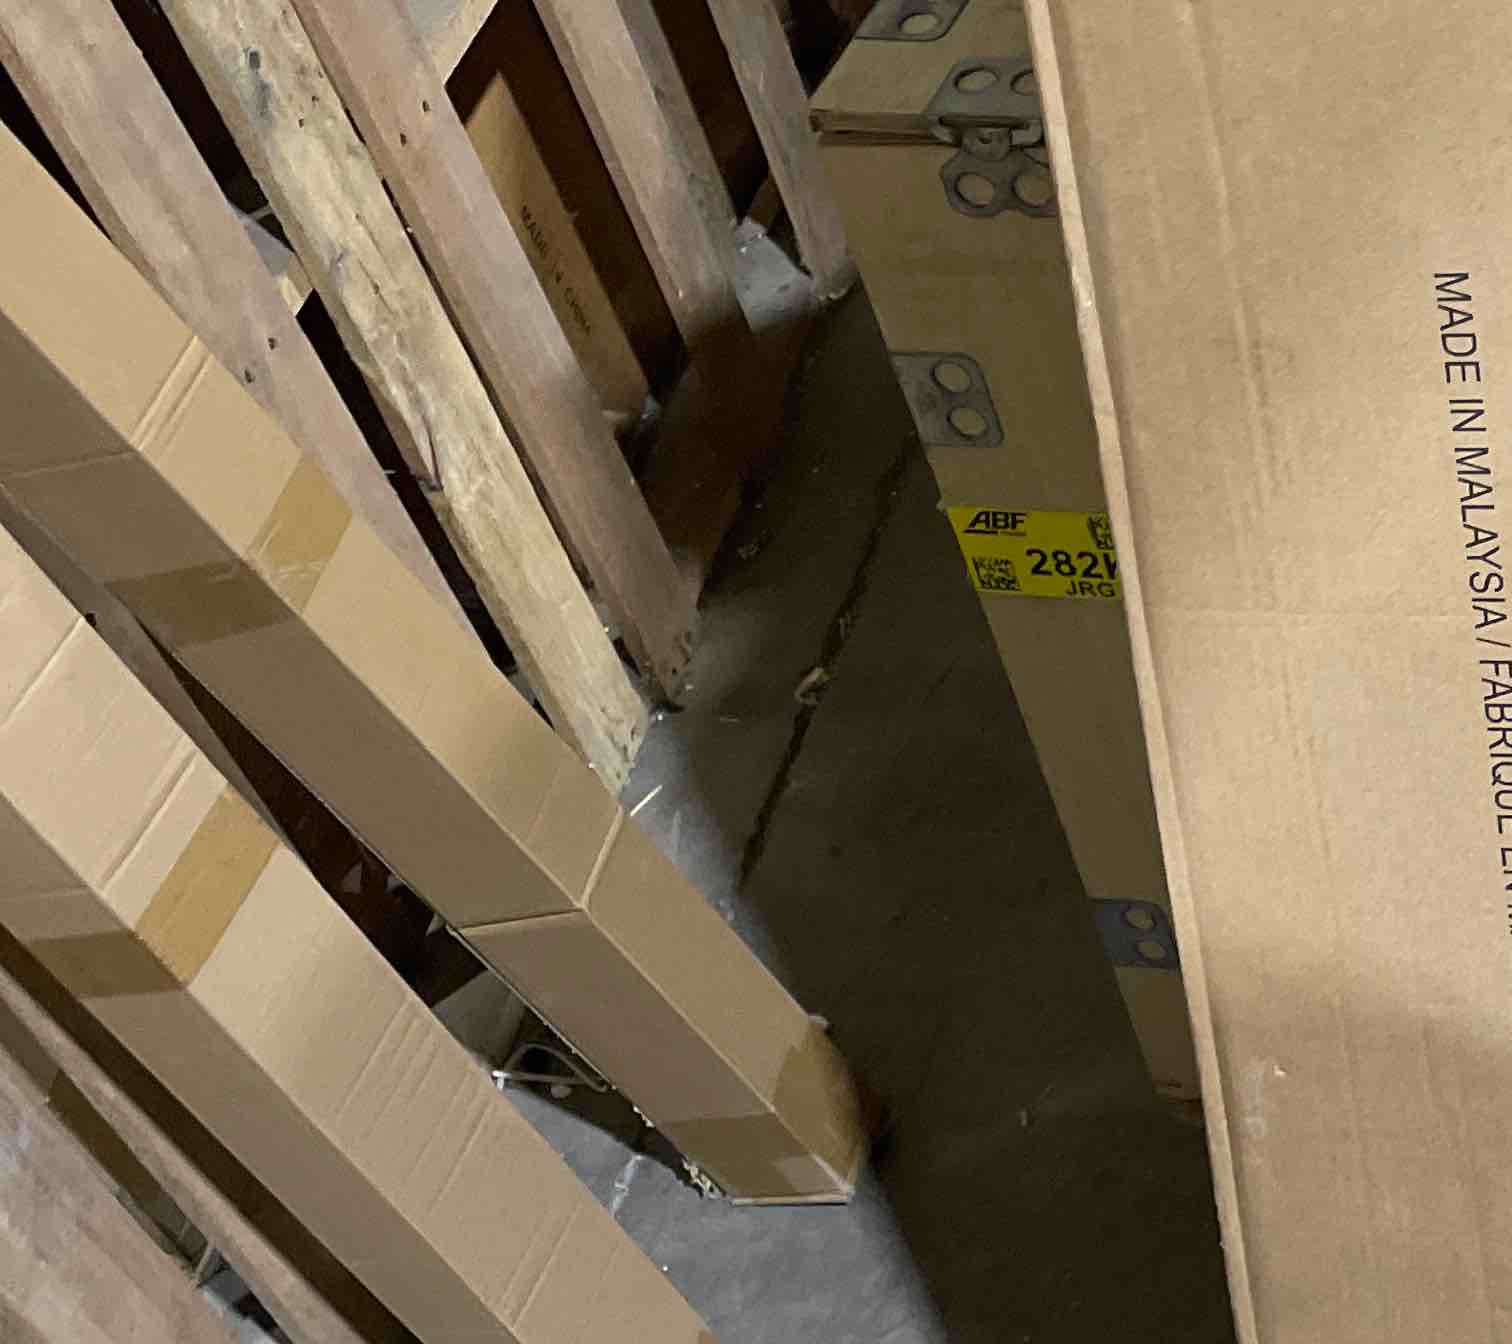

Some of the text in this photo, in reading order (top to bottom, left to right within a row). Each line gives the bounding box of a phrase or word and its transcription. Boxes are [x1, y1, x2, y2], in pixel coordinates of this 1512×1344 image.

[1433, 272, 1481, 384] MADE
[1449, 399, 1487, 432] IN
[968, 511, 1028, 532] ABF
[1454, 447, 1507, 629] MALAYSIA
[1065, 580, 1116, 598] JRG
